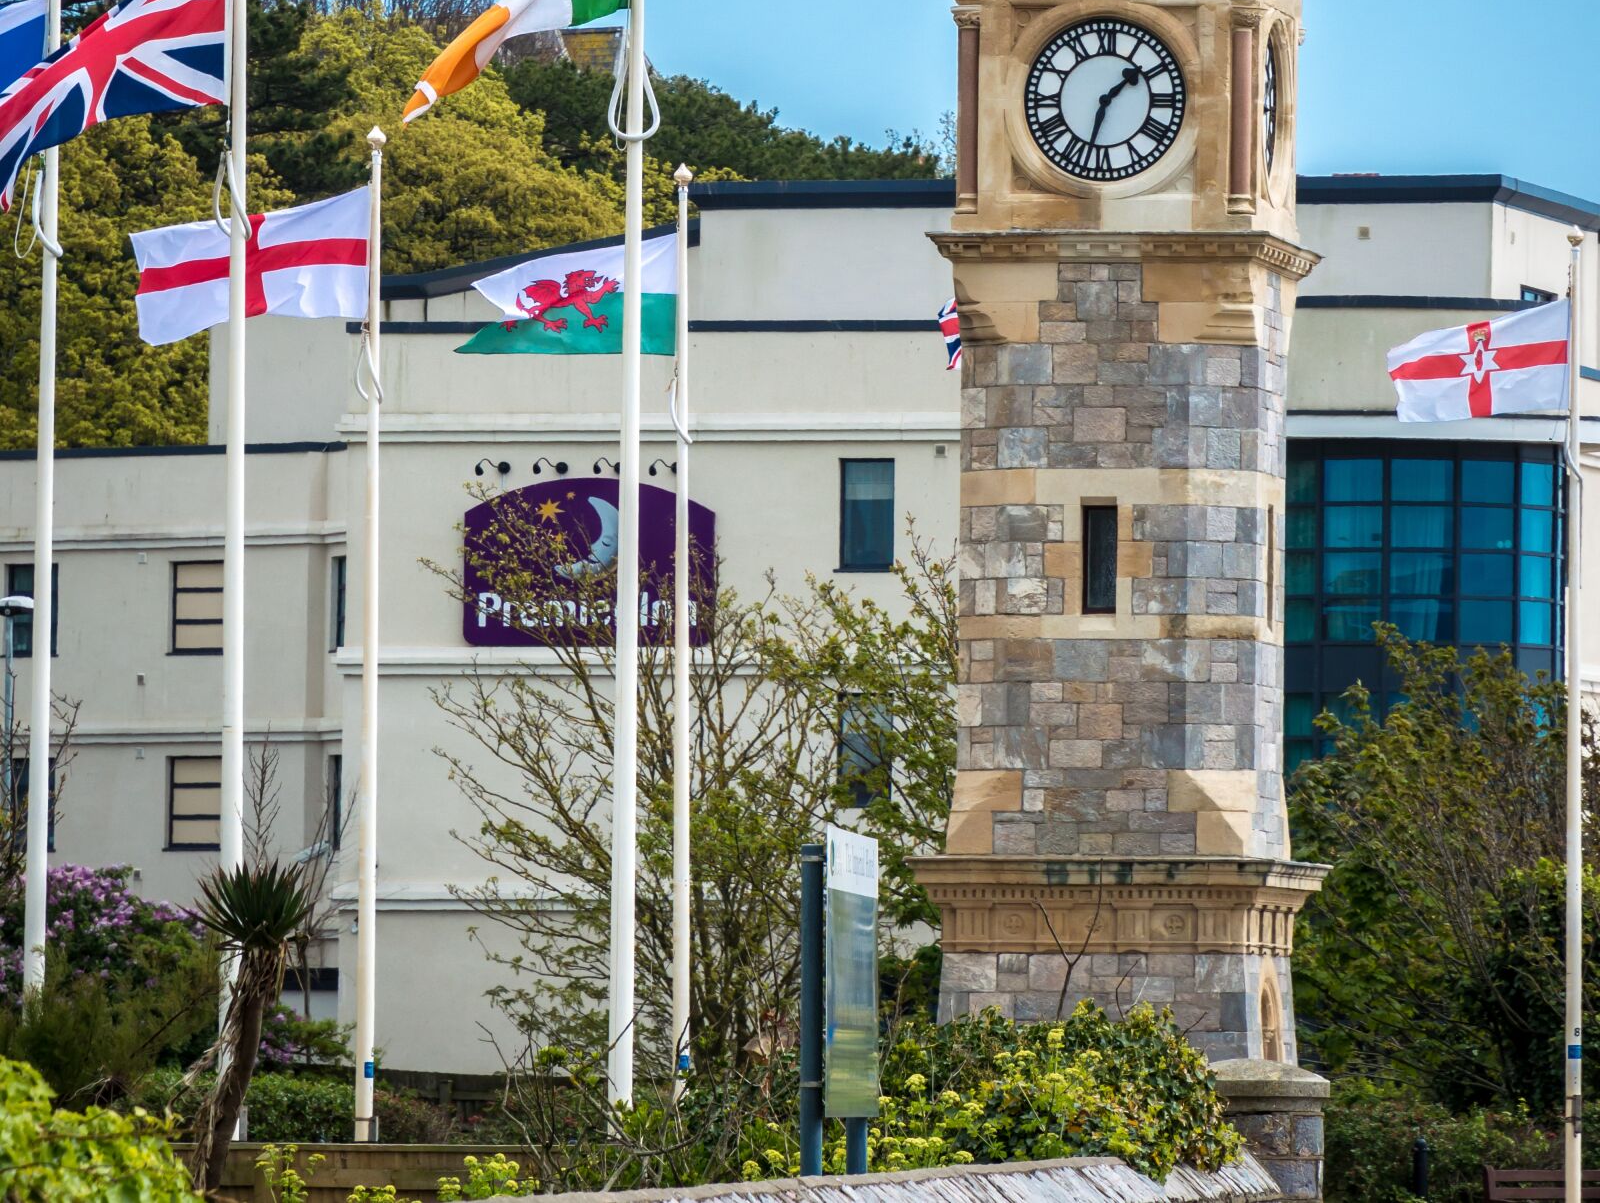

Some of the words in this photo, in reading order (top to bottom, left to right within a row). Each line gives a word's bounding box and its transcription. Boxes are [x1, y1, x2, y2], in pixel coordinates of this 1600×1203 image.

[1065, 35, 1089, 60] XI
[1096, 31, 1117, 55] XII
[1044, 61, 1069, 80] X
[1144, 61, 1168, 79] II
[1037, 93, 1060, 108] IX
[1150, 93, 1173, 108] III
[1040, 116, 1069, 145] VIII
[1141, 117, 1170, 144] IIII
[1127, 141, 1144, 163] V
[478, 592, 618, 627] Premie
